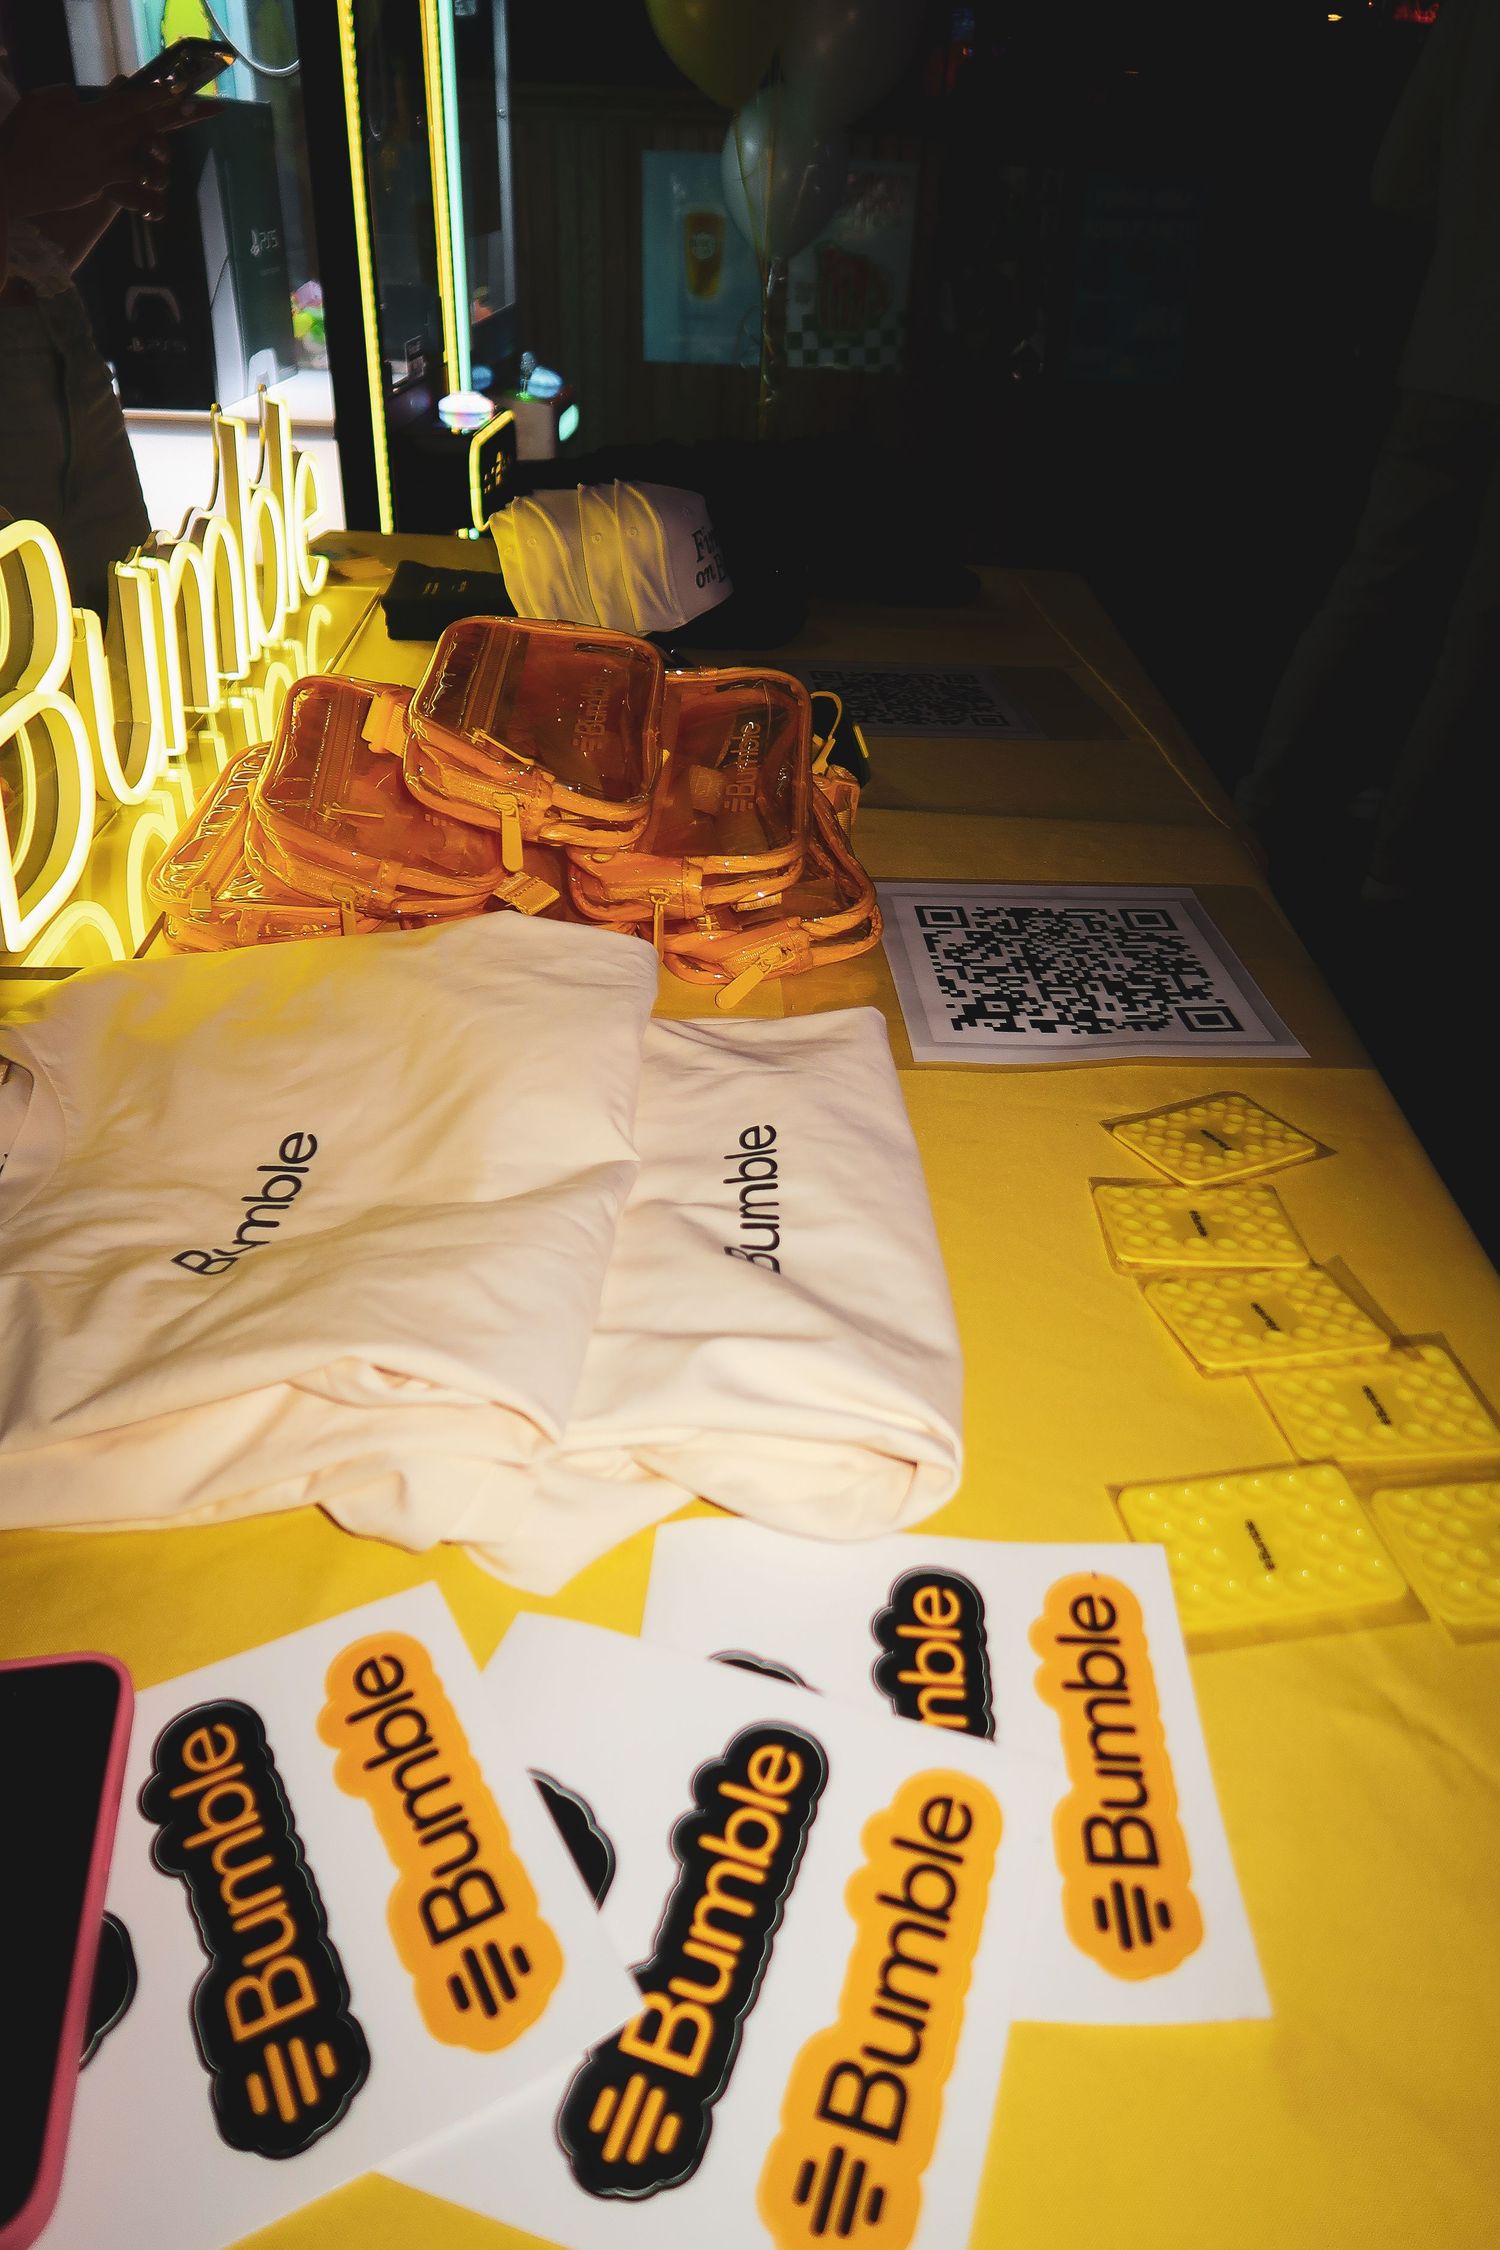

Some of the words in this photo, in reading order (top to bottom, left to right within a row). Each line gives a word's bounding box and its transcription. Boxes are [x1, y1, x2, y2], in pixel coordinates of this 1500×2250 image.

[0, 390, 330, 953] Bumble
[725, 720, 761, 797] Bumble
[722, 1124, 781, 1275] Bumble
[345, 1651, 506, 1947] Bumble
[895, 1584, 970, 1729] mble
[1055, 1592, 1162, 1870] Bumble
[168, 1721, 319, 2044] Bumble
[618, 1741, 806, 2078] Bumble
[816, 1792, 976, 2144] Bumble
